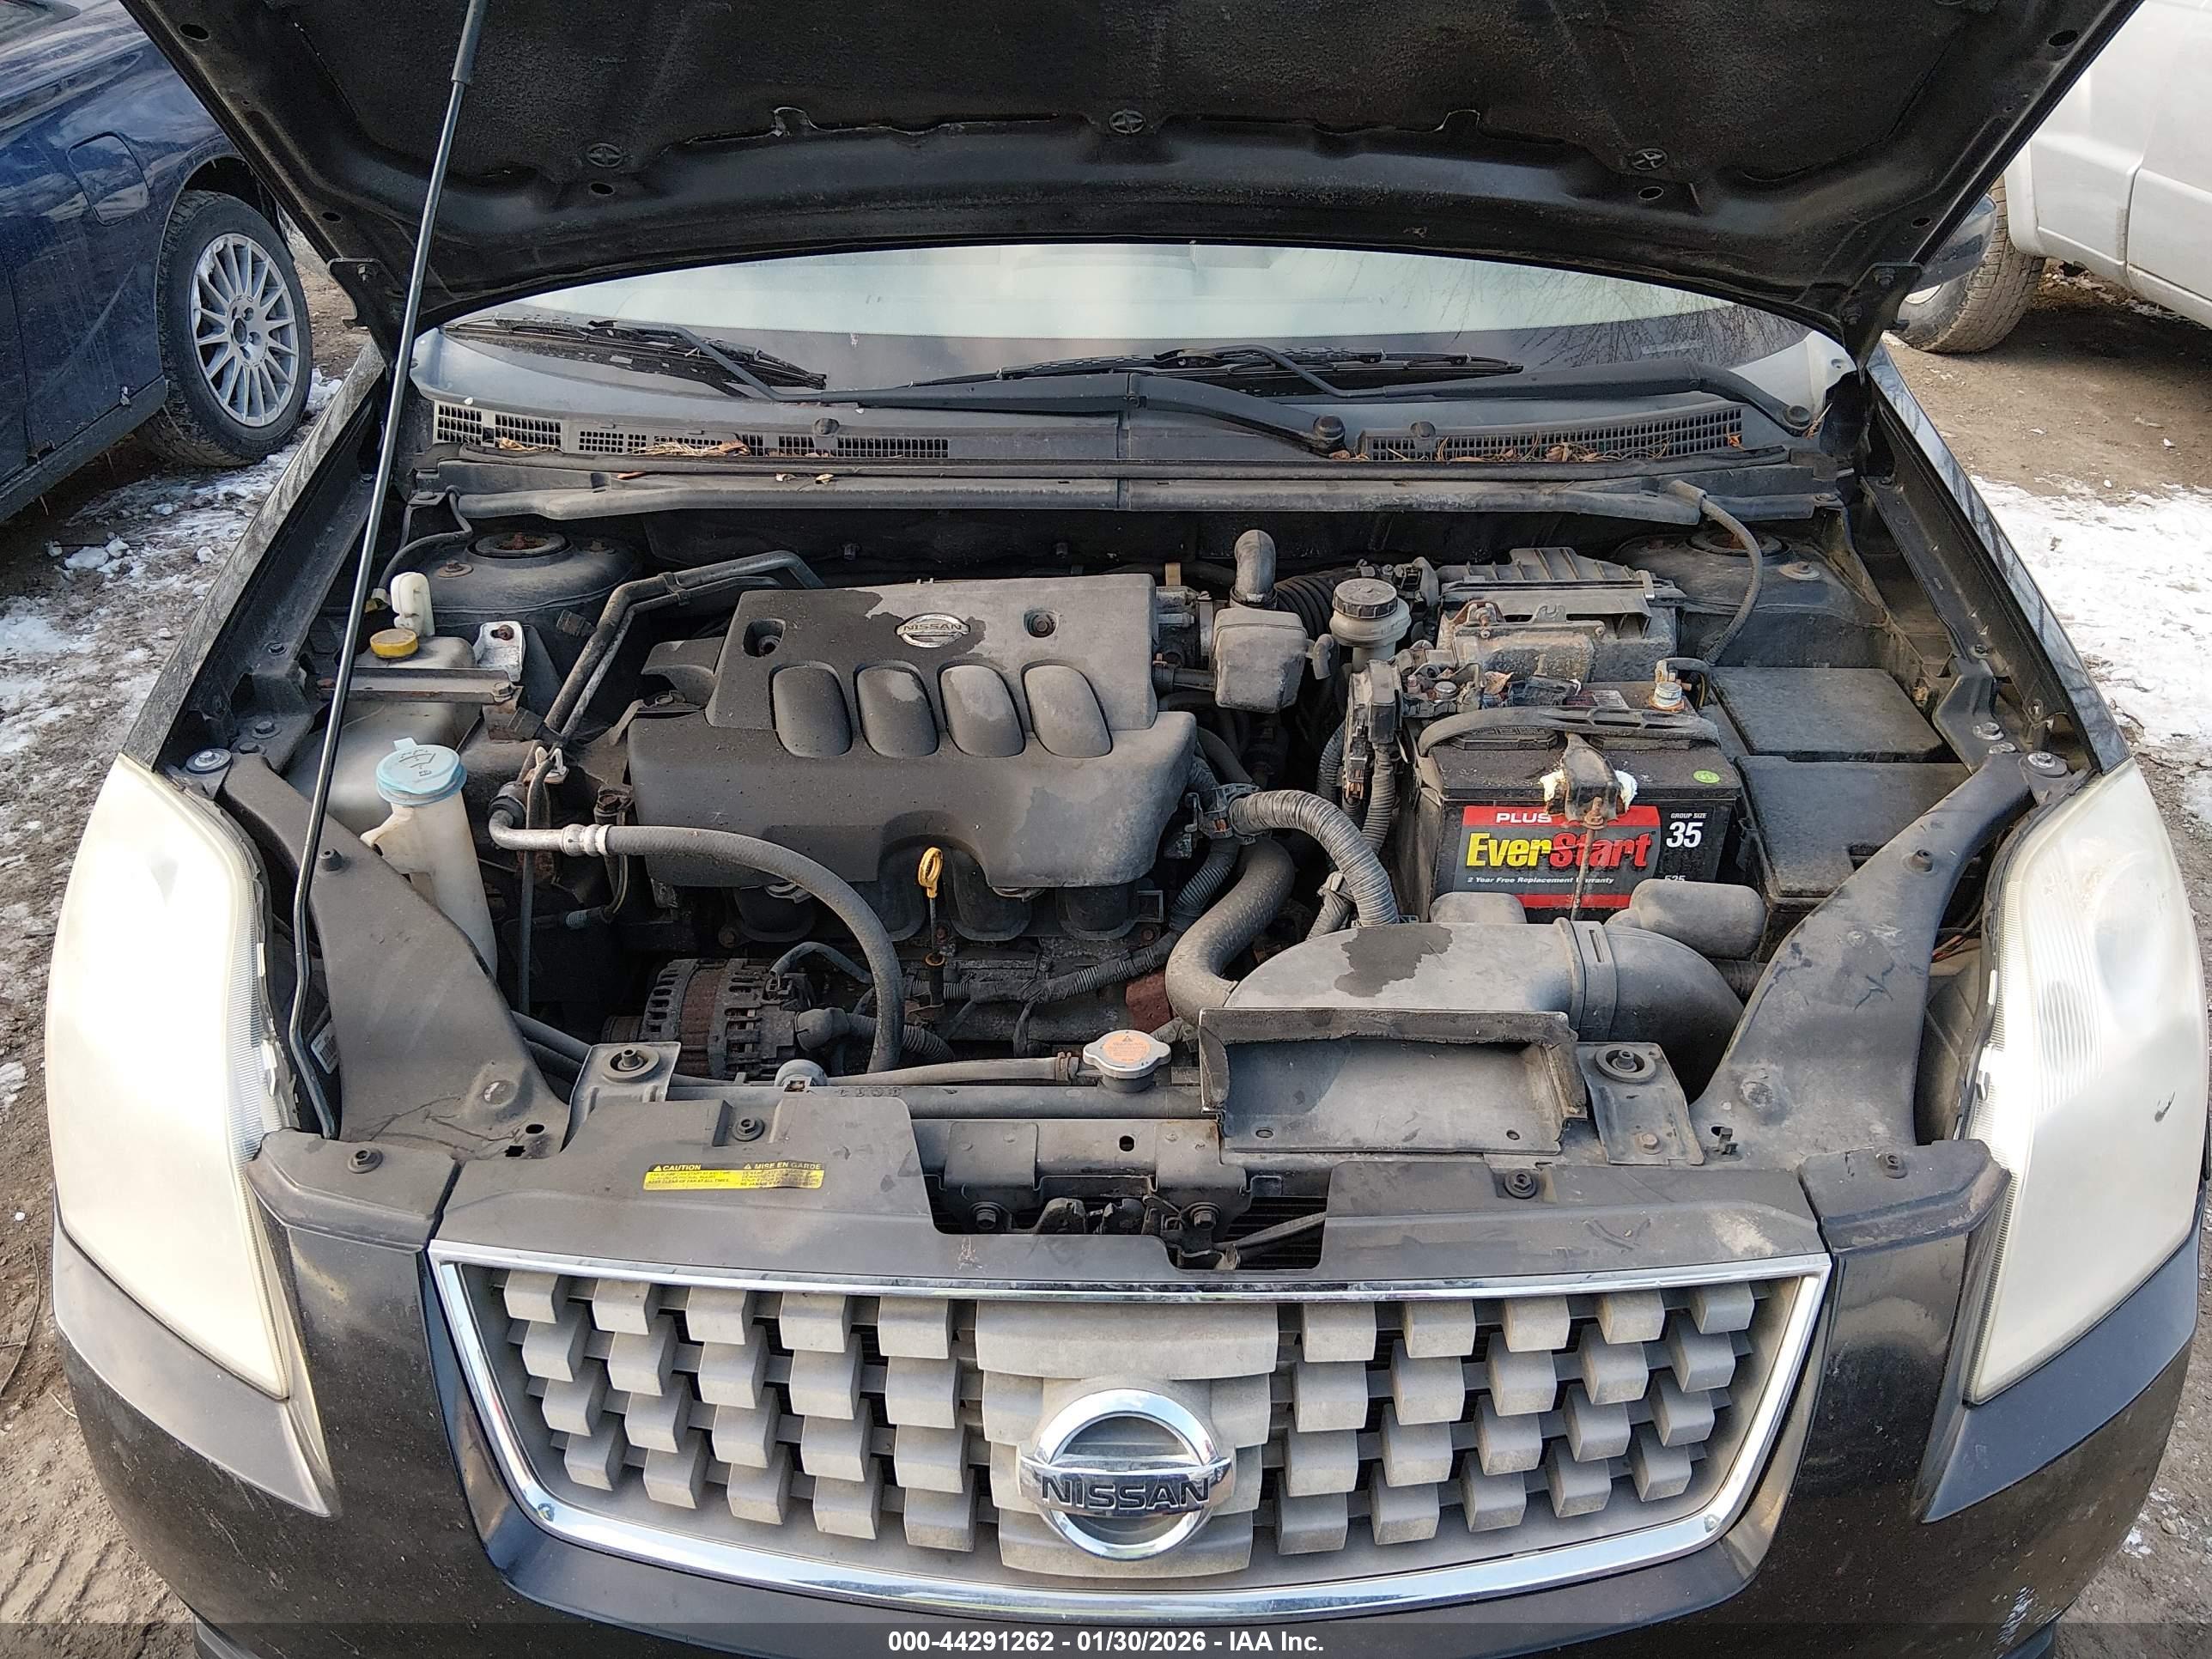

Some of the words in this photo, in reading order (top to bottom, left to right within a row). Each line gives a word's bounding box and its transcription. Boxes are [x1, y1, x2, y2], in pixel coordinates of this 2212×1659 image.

[1495, 813, 1553, 823] PLUS
[1466, 832, 1652, 868] EverStart
[1666, 821, 1704, 848] 35
[1041, 1475, 1210, 1510] NISSAN
